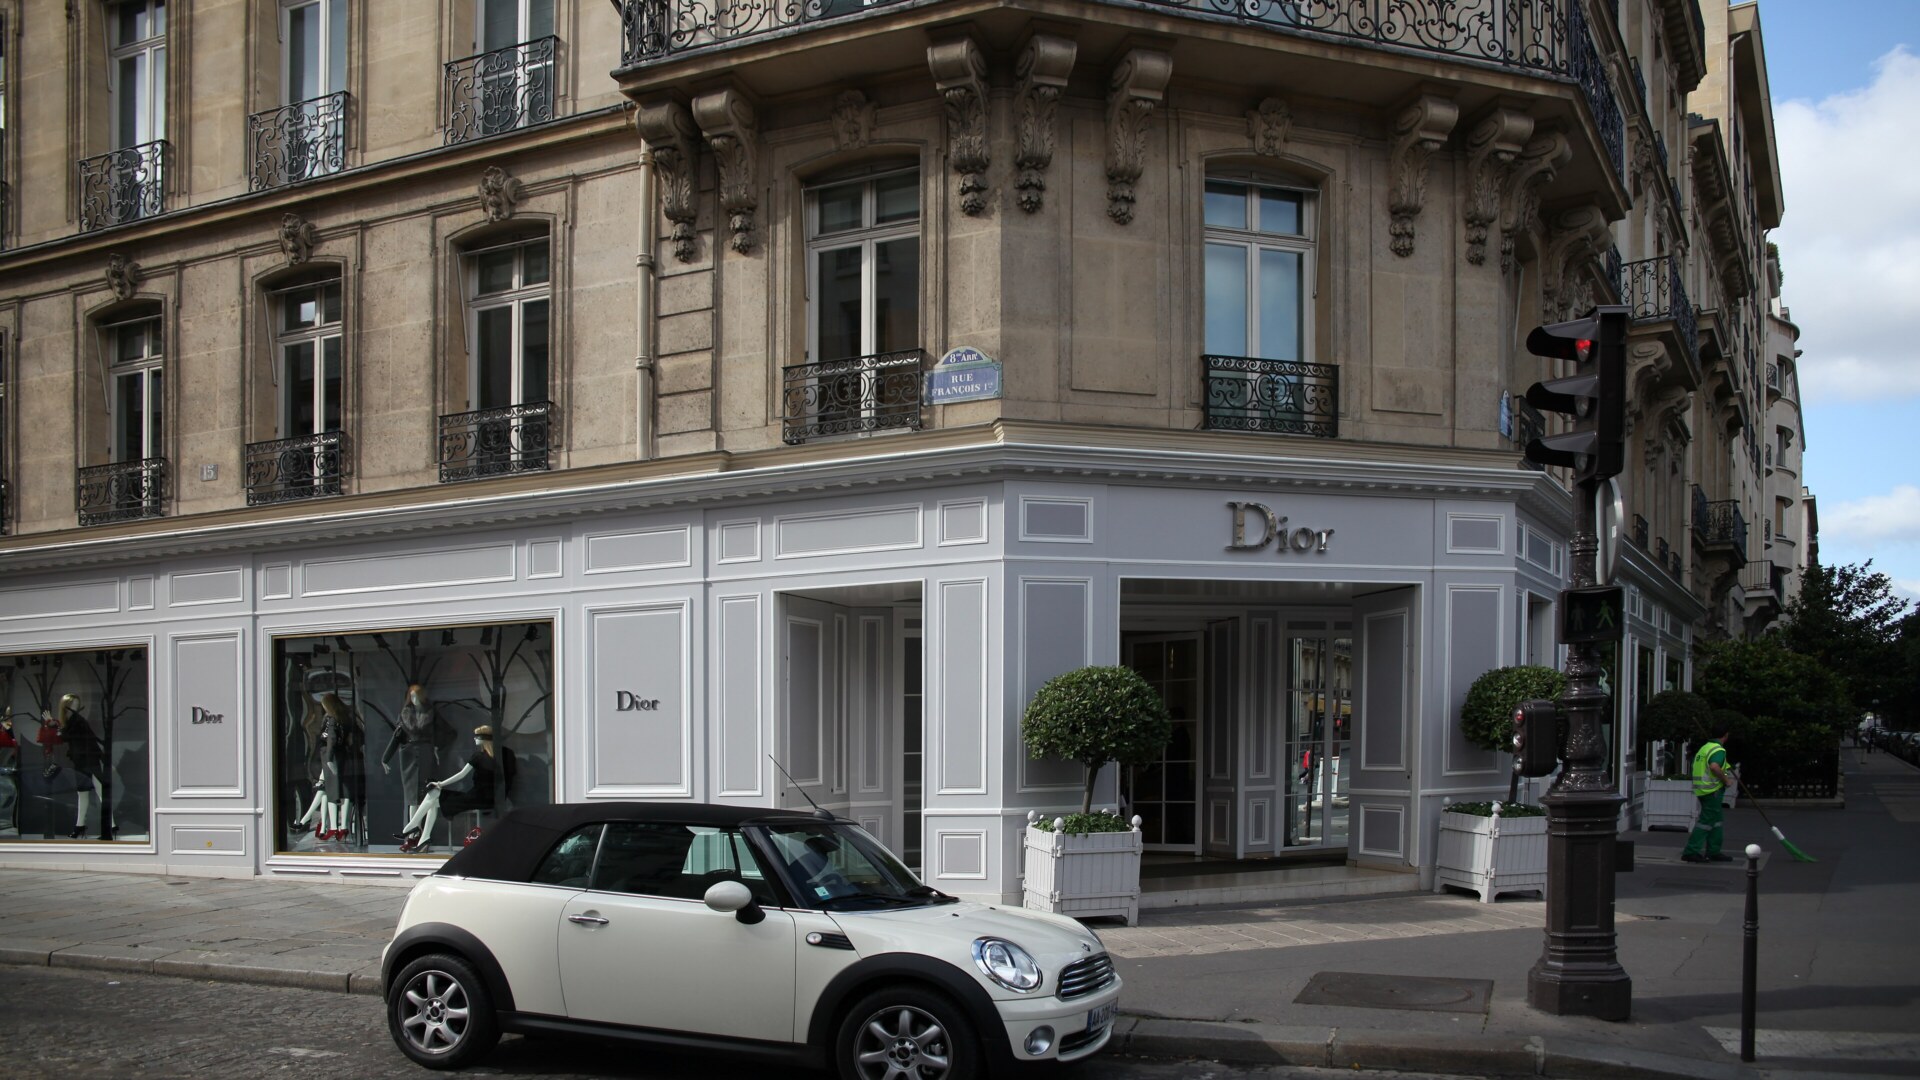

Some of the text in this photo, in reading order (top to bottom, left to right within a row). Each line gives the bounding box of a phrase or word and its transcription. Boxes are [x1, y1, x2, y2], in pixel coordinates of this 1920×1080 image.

[951, 373, 974, 384] RUE
[931, 383, 981, 397] FRANÇOIS
[1225, 501, 1335, 554] Dior
[615, 690, 661, 712] Dior
[191, 706, 225, 725] Dior
